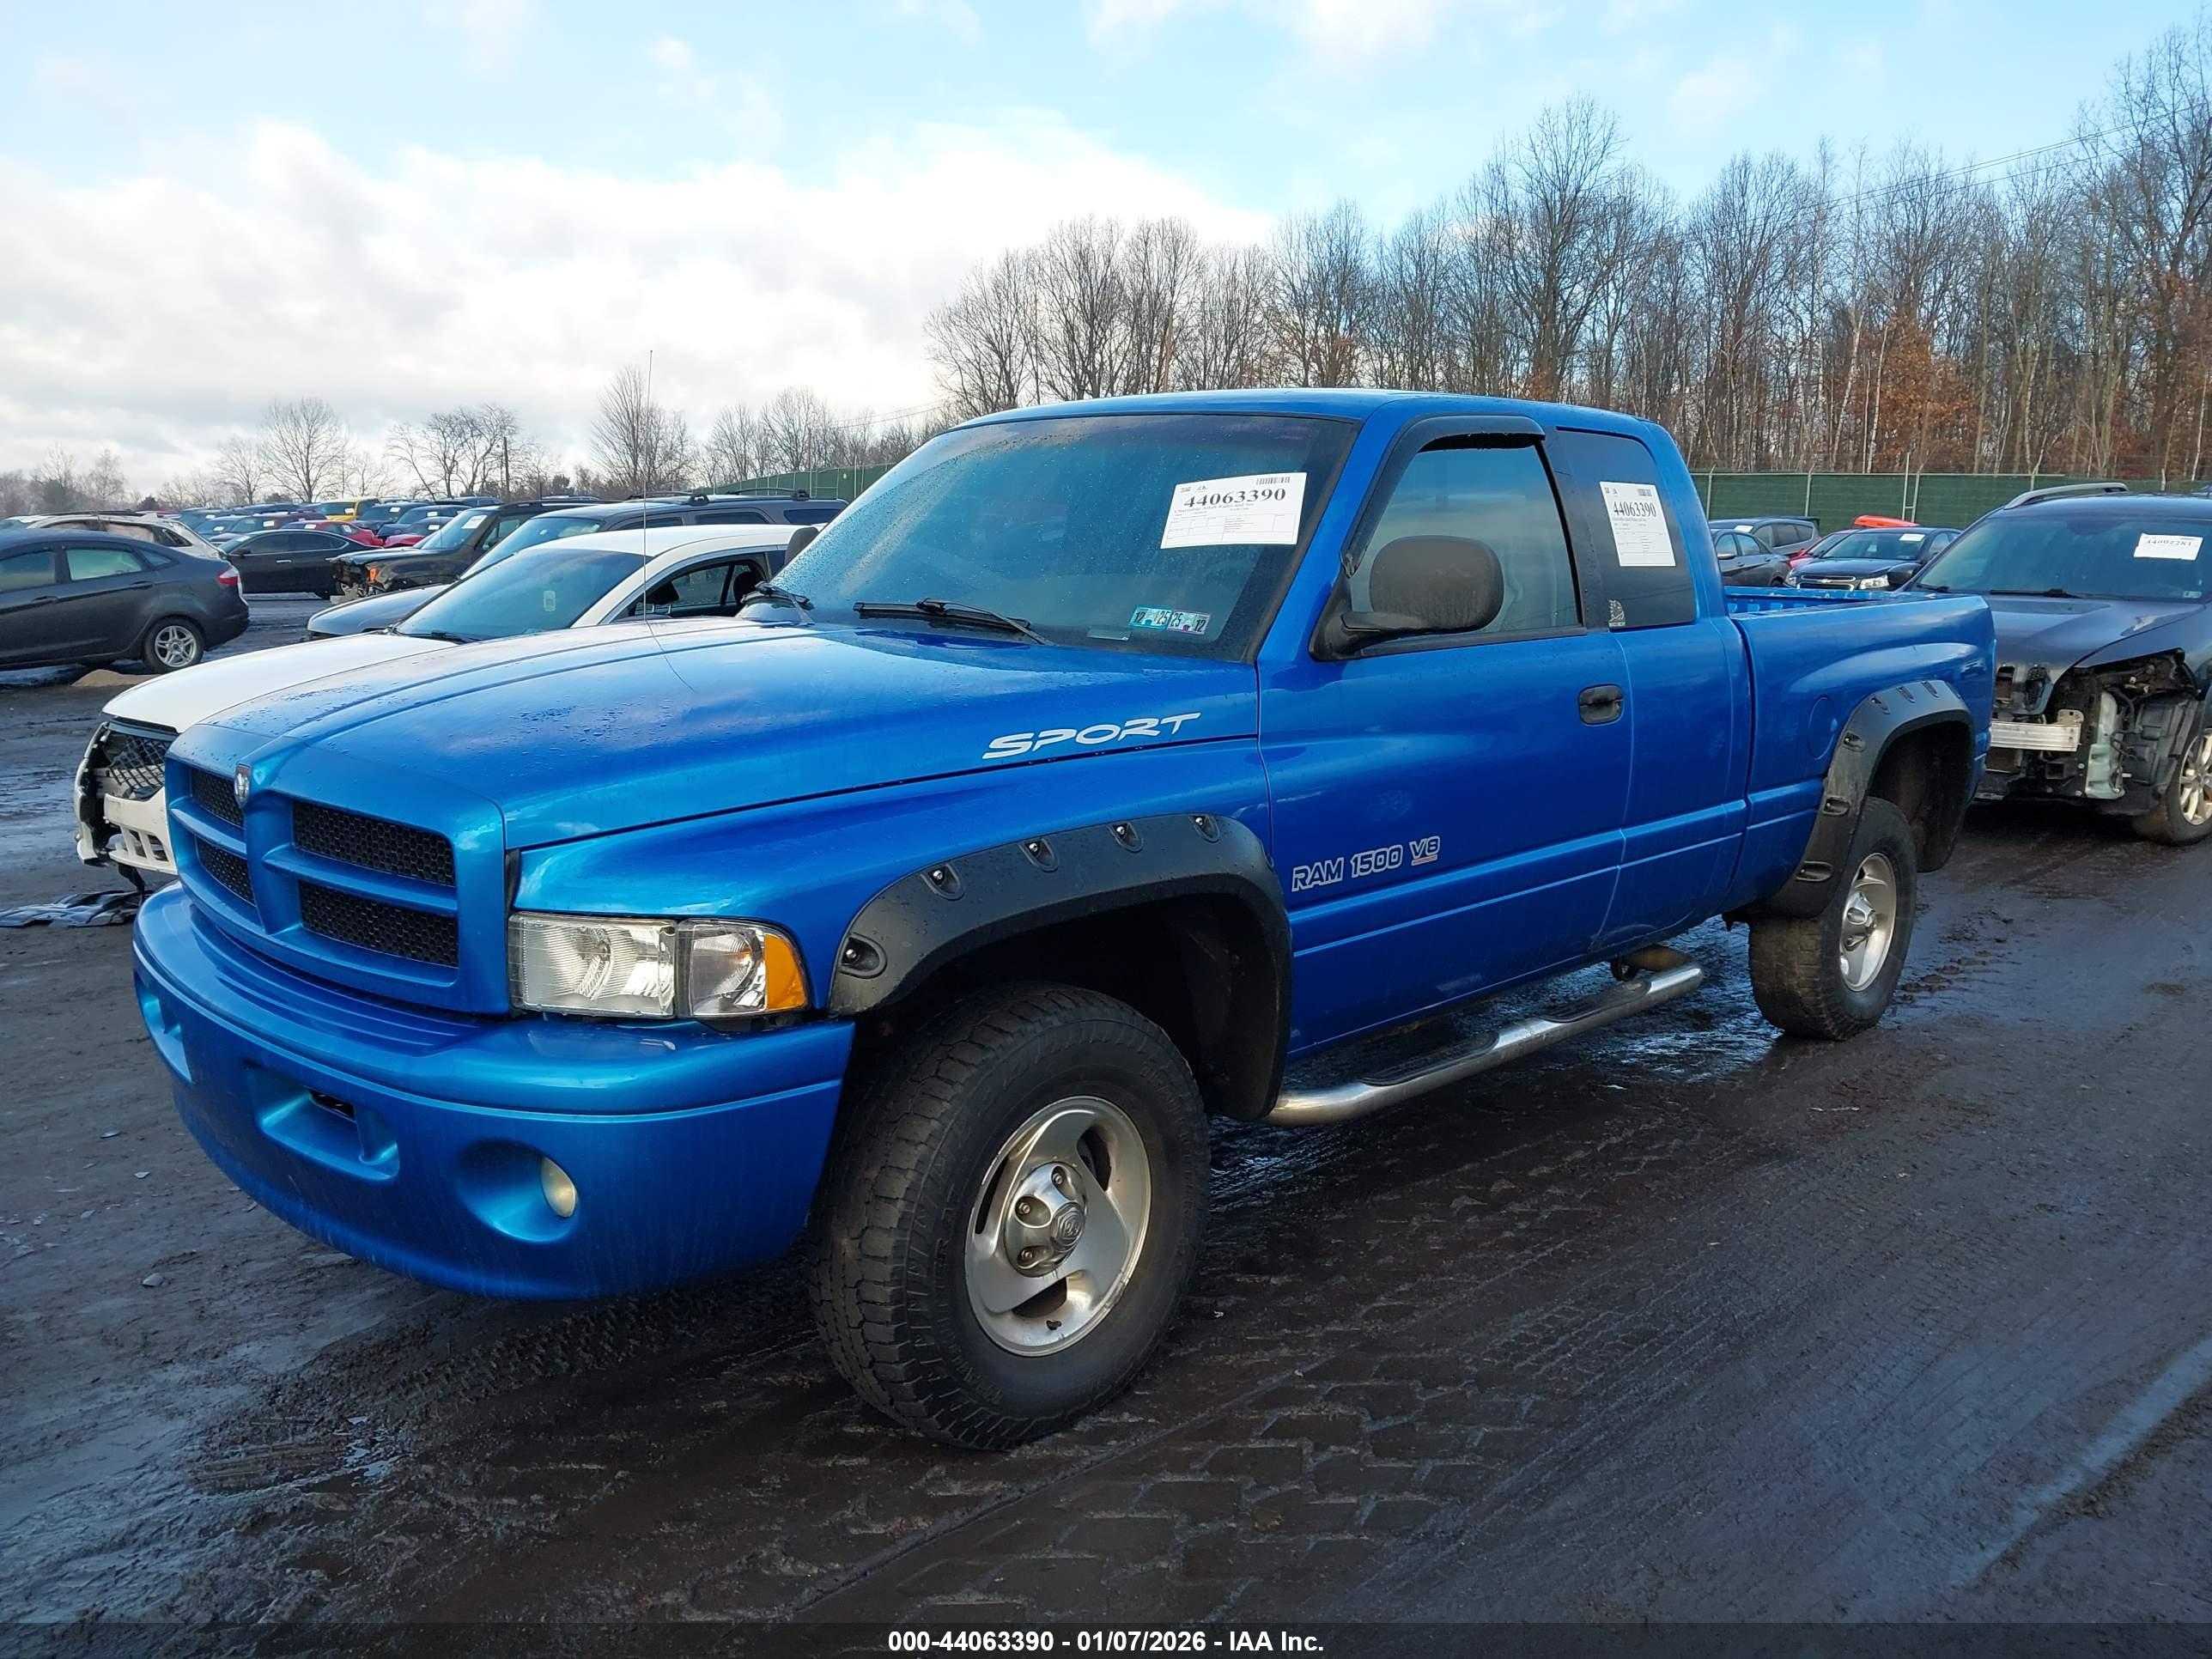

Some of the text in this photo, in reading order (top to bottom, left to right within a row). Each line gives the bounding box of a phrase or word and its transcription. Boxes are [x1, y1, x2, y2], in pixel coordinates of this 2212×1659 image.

[1184, 489, 1286, 507] 44063390
[1613, 501, 1656, 517] 44063390
[1133, 611, 1170, 625] 12 25
[1170, 612, 1207, 633] 25 12
[981, 712, 1201, 759] SPORT
[1291, 836, 1440, 892] RAM 1500 V8
